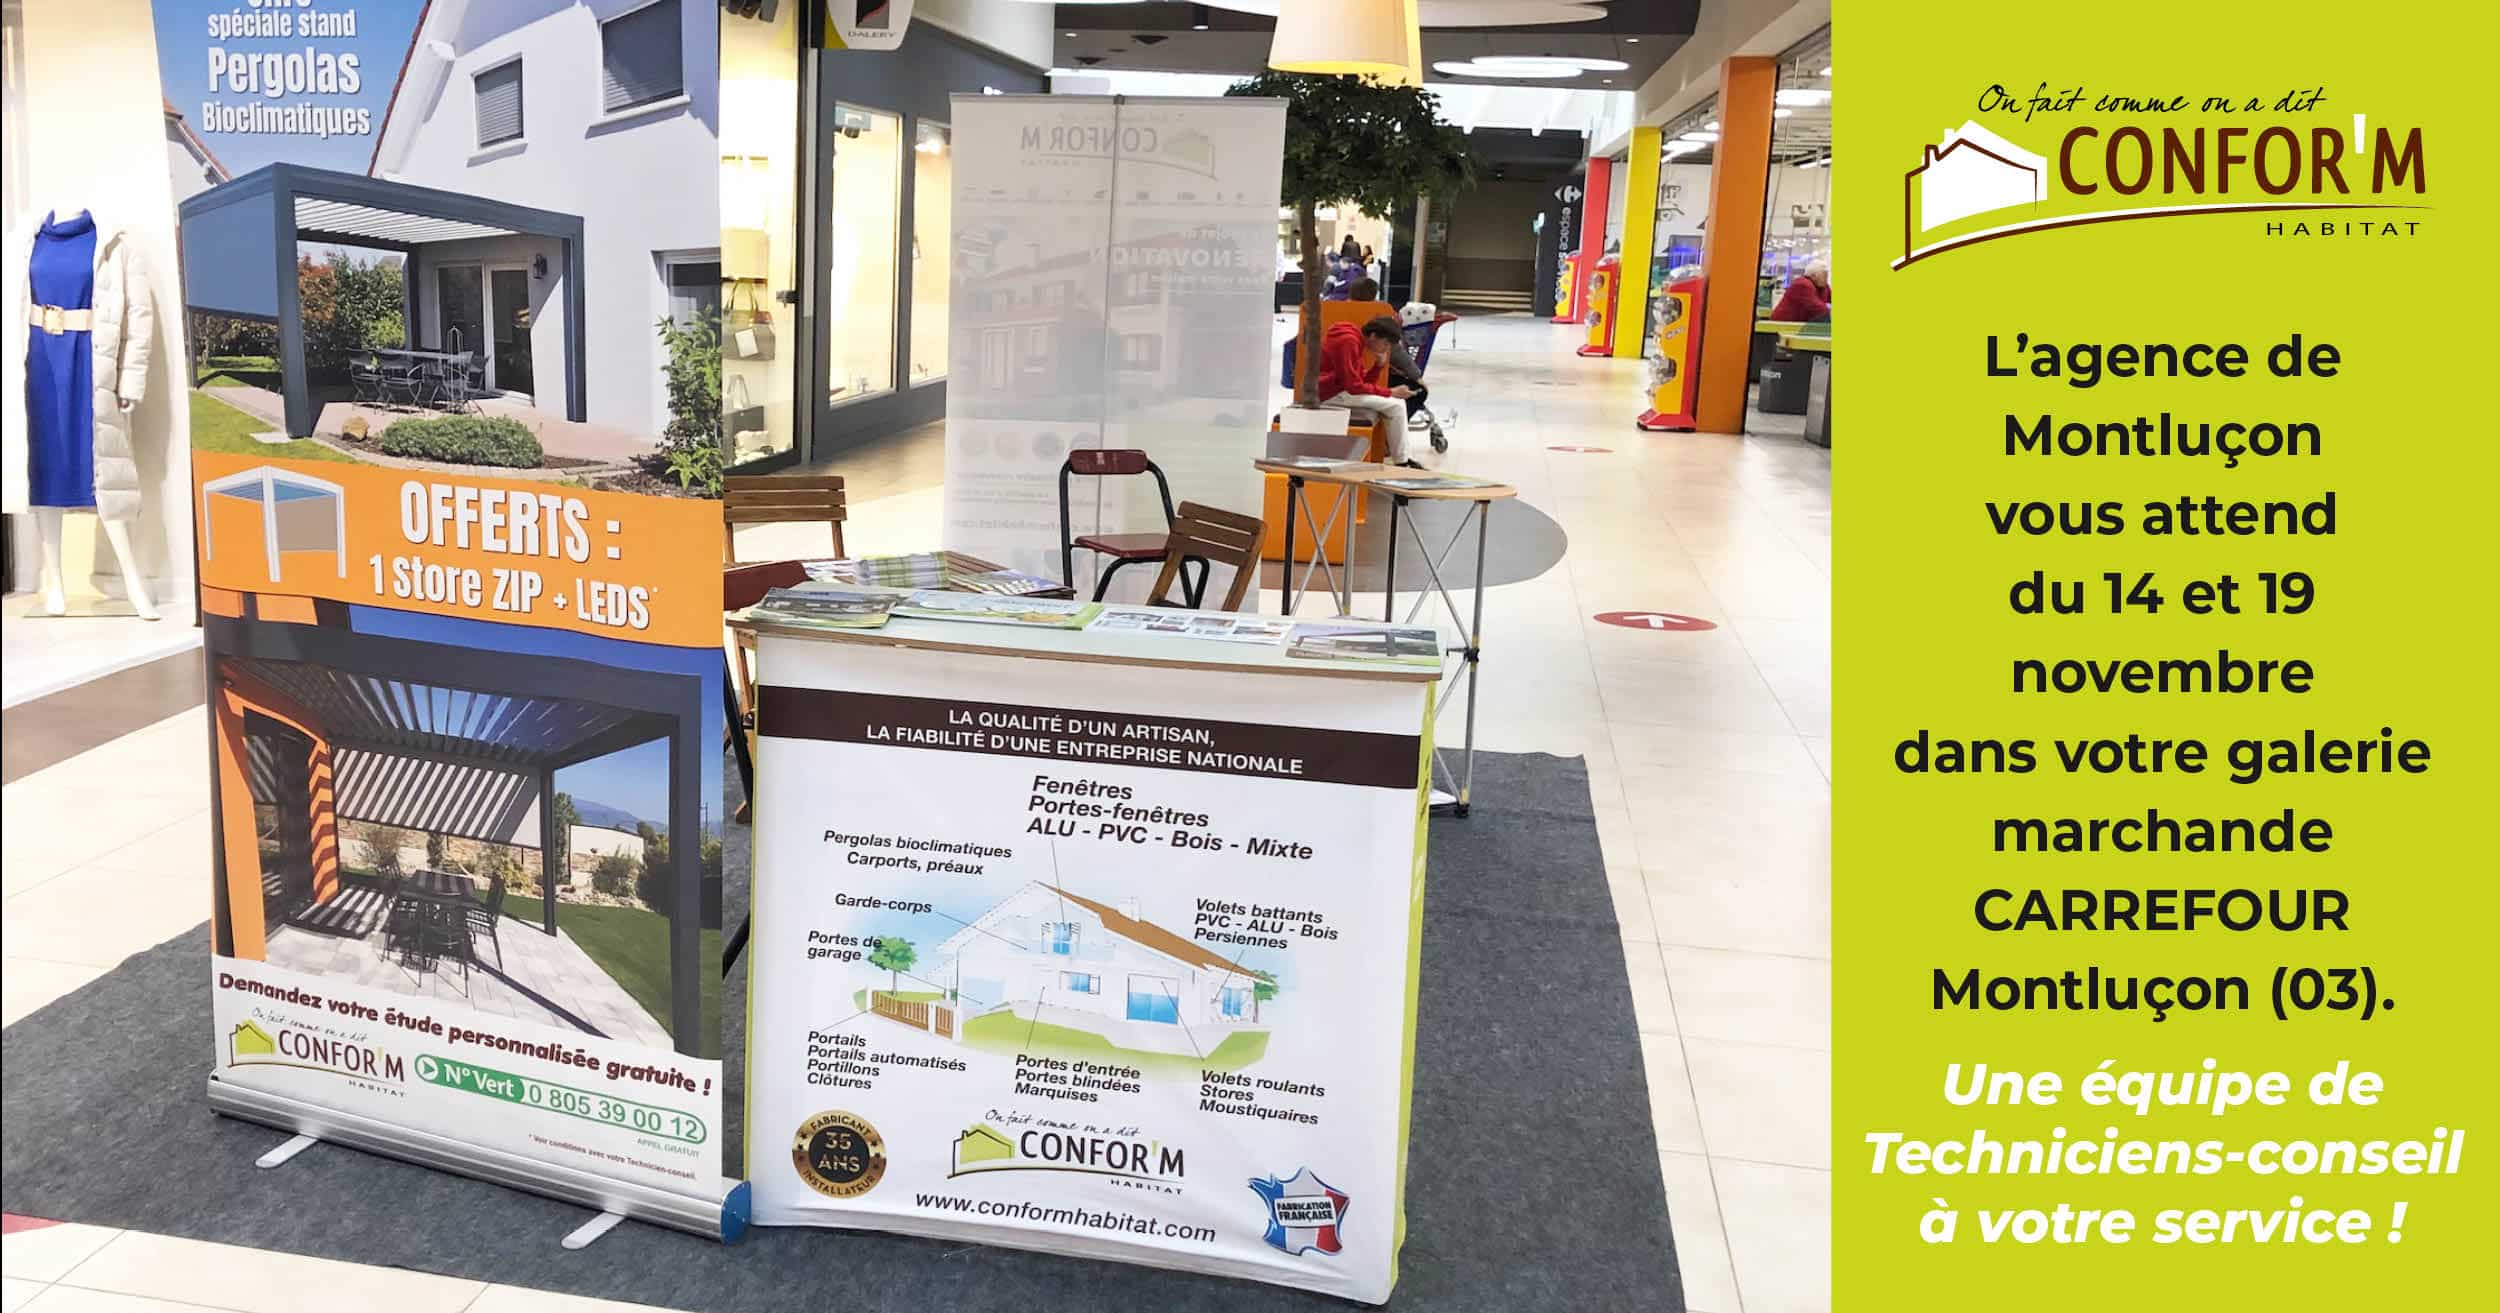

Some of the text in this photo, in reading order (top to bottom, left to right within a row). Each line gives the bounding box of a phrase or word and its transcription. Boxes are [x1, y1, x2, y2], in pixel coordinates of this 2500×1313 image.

[208, 8, 357, 41] spéciale stand
[208, 46, 361, 99] Pergolas
[202, 101, 371, 140] Bioclimatiques
[400, 480, 591, 563] OFFERTS
[369, 553, 385, 597] 1
[392, 555, 483, 608] Store
[492, 567, 544, 614] ZIP
[949, 710, 973, 726] LA
[978, 711, 1063, 733] QUALITÉ
[1122, 724, 1216, 747] ARTISAN,
[866, 725, 890, 740] LA
[896, 727, 985, 749] FIABILITÉ
[1057, 740, 1181, 765] ENTREPRISE
[1187, 751, 1304, 776] NATIONALE
[1032, 775, 1133, 800] Fenêtres
[1028, 796, 1209, 828] Portes-fenêtres
[824, 830, 1013, 858] Pergolas bioclimatiques
[1027, 817, 1075, 838] ALU
[1098, 823, 1148, 845] PVC
[1171, 830, 1224, 852] Bois
[1246, 838, 1313, 860] Mixte
[847, 851, 984, 876] Carports, préaux
[835, 893, 932, 915] Garde-corps
[1196, 898, 1324, 924] Volets battants
[808, 930, 883, 949] Portes de
[1194, 913, 1231, 928] PVC
[1246, 919, 1284, 935] ALU
[1300, 924, 1339, 941] Bois
[1194, 928, 1289, 949] Persiennes
[807, 946, 862, 962] garage
[219, 973, 322, 1009] Demandez
[328, 999, 379, 1022] votre
[385, 1008, 443, 1036] étude
[448, 1025, 600, 1071] personnalisée
[606, 1058, 696, 1094] gratuite
[808, 1031, 867, 1047] Portails
[807, 1045, 967, 1071] Portails automatisés
[807, 1059, 880, 1077] Portillons
[1015, 1054, 1141, 1080] Portes d'entrée
[807, 1072, 873, 1090] Clôtures
[1014, 1082, 1098, 1103] Marquises
[1015, 1068, 1141, 1094] Portes blindées
[1200, 1084, 1254, 1101] Stores
[1201, 1070, 1325, 1097] Volets roulants
[529, 1083, 698, 1140] 0 805 39 00 12
[1199, 1098, 1319, 1125] Moustiquaires
[810, 1114, 871, 1136] FABRICANT
[824, 1132, 852, 1149] 35
[818, 1156, 861, 1173] ANS
[1021, 1130, 1184, 1178] CONFOR'M
[803, 1170, 877, 1195] INSTALLATEUR
[1110, 1178, 1184, 1195] HABITAT
[916, 1192, 1216, 1243] www.conformhabitat.com
[1277, 1200, 1331, 1211] FABRICATION
[1279, 1208, 1334, 1221] FRANÇAISE
